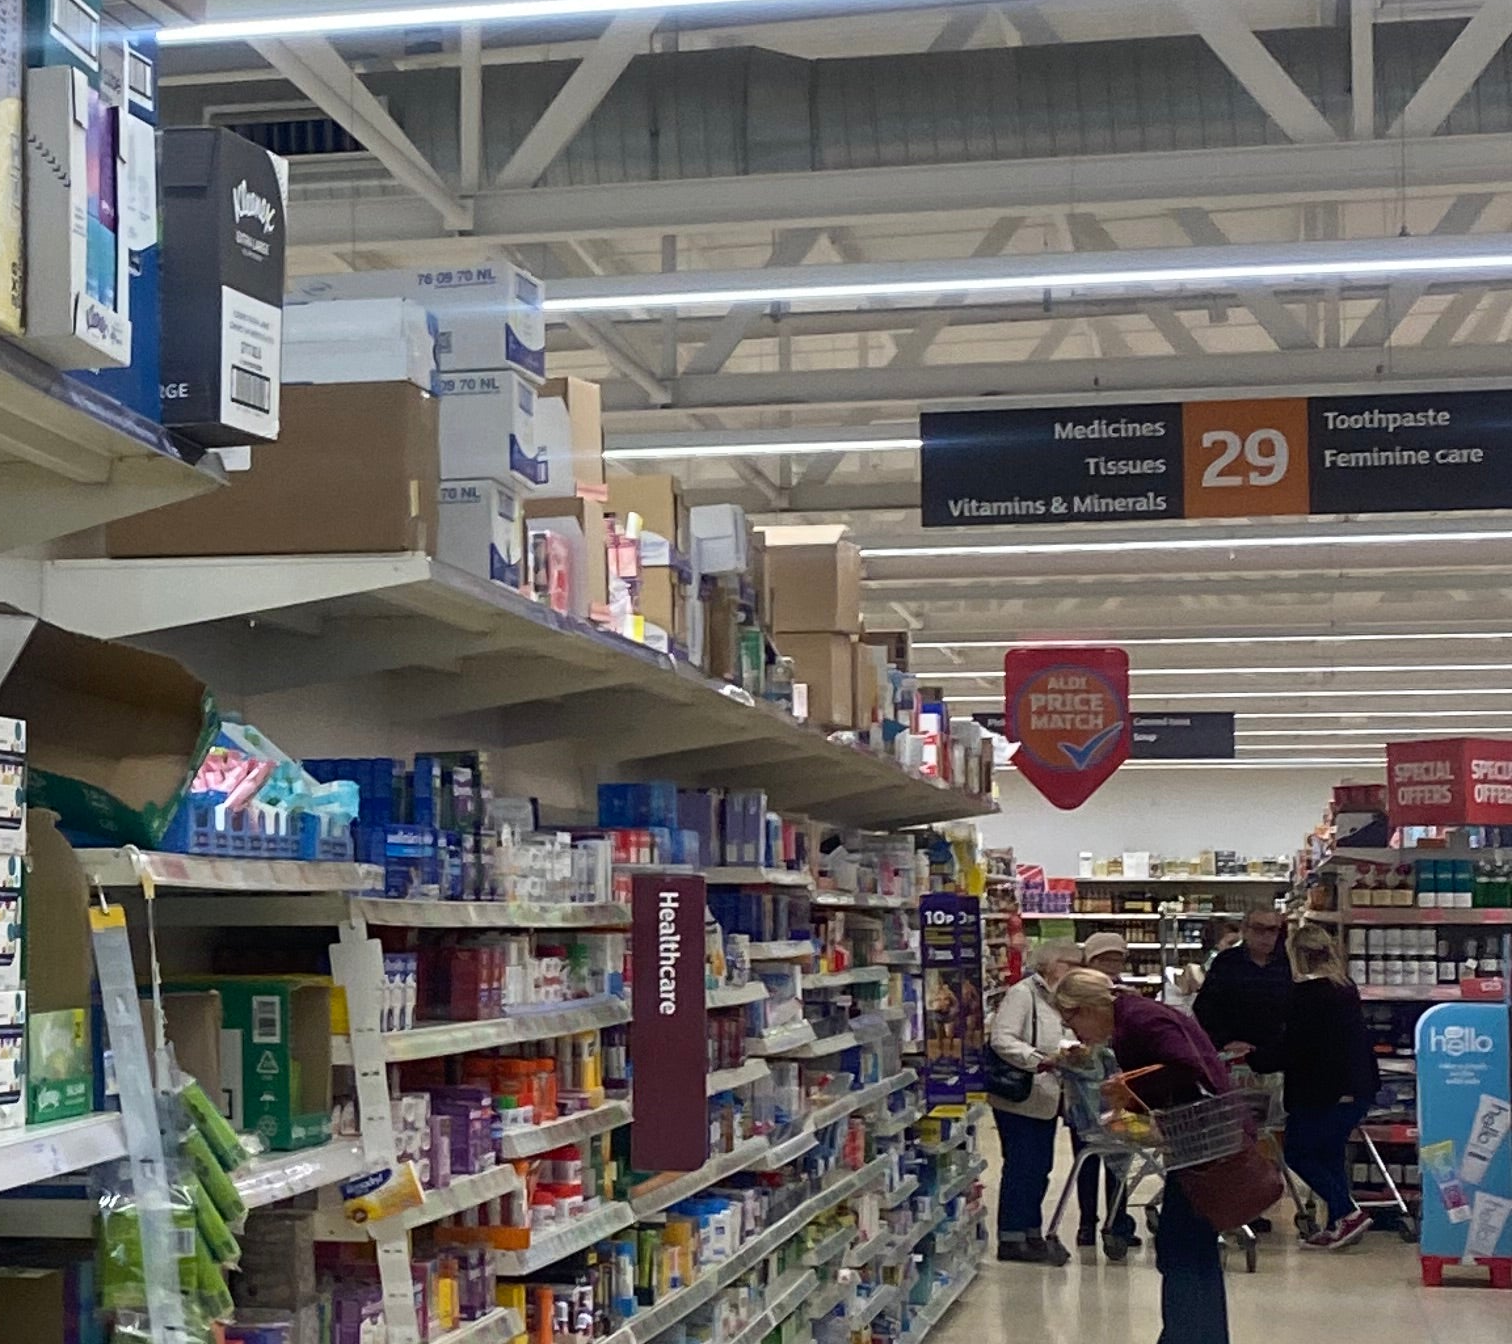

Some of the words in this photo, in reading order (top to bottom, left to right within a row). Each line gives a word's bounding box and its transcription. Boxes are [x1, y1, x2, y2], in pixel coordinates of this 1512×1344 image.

[477, 269, 496, 281] NL
[481, 378, 499, 390] NL
[1055, 419, 1166, 440] Medicines
[1324, 408, 1451, 432] Toothpaste
[1087, 457, 1166, 476] Tissues
[1201, 429, 1289, 489] 29
[1324, 447, 1430, 468] Feminine
[1435, 446, 1483, 464] care
[461, 487, 480, 499] NL
[949, 497, 1045, 518] Vitamins
[1051, 496, 1068, 514] &
[1073, 492, 1166, 513] Minerals
[1047, 676, 1088, 690] ALDI
[1031, 693, 1104, 712] PRICE
[1031, 713, 1104, 731] MATCH
[1394, 760, 1455, 783] SPECIAL
[1396, 784, 1453, 807] OFFERS
[658, 891, 680, 1016] Healthcare
[1430, 1026, 1494, 1056] hello
